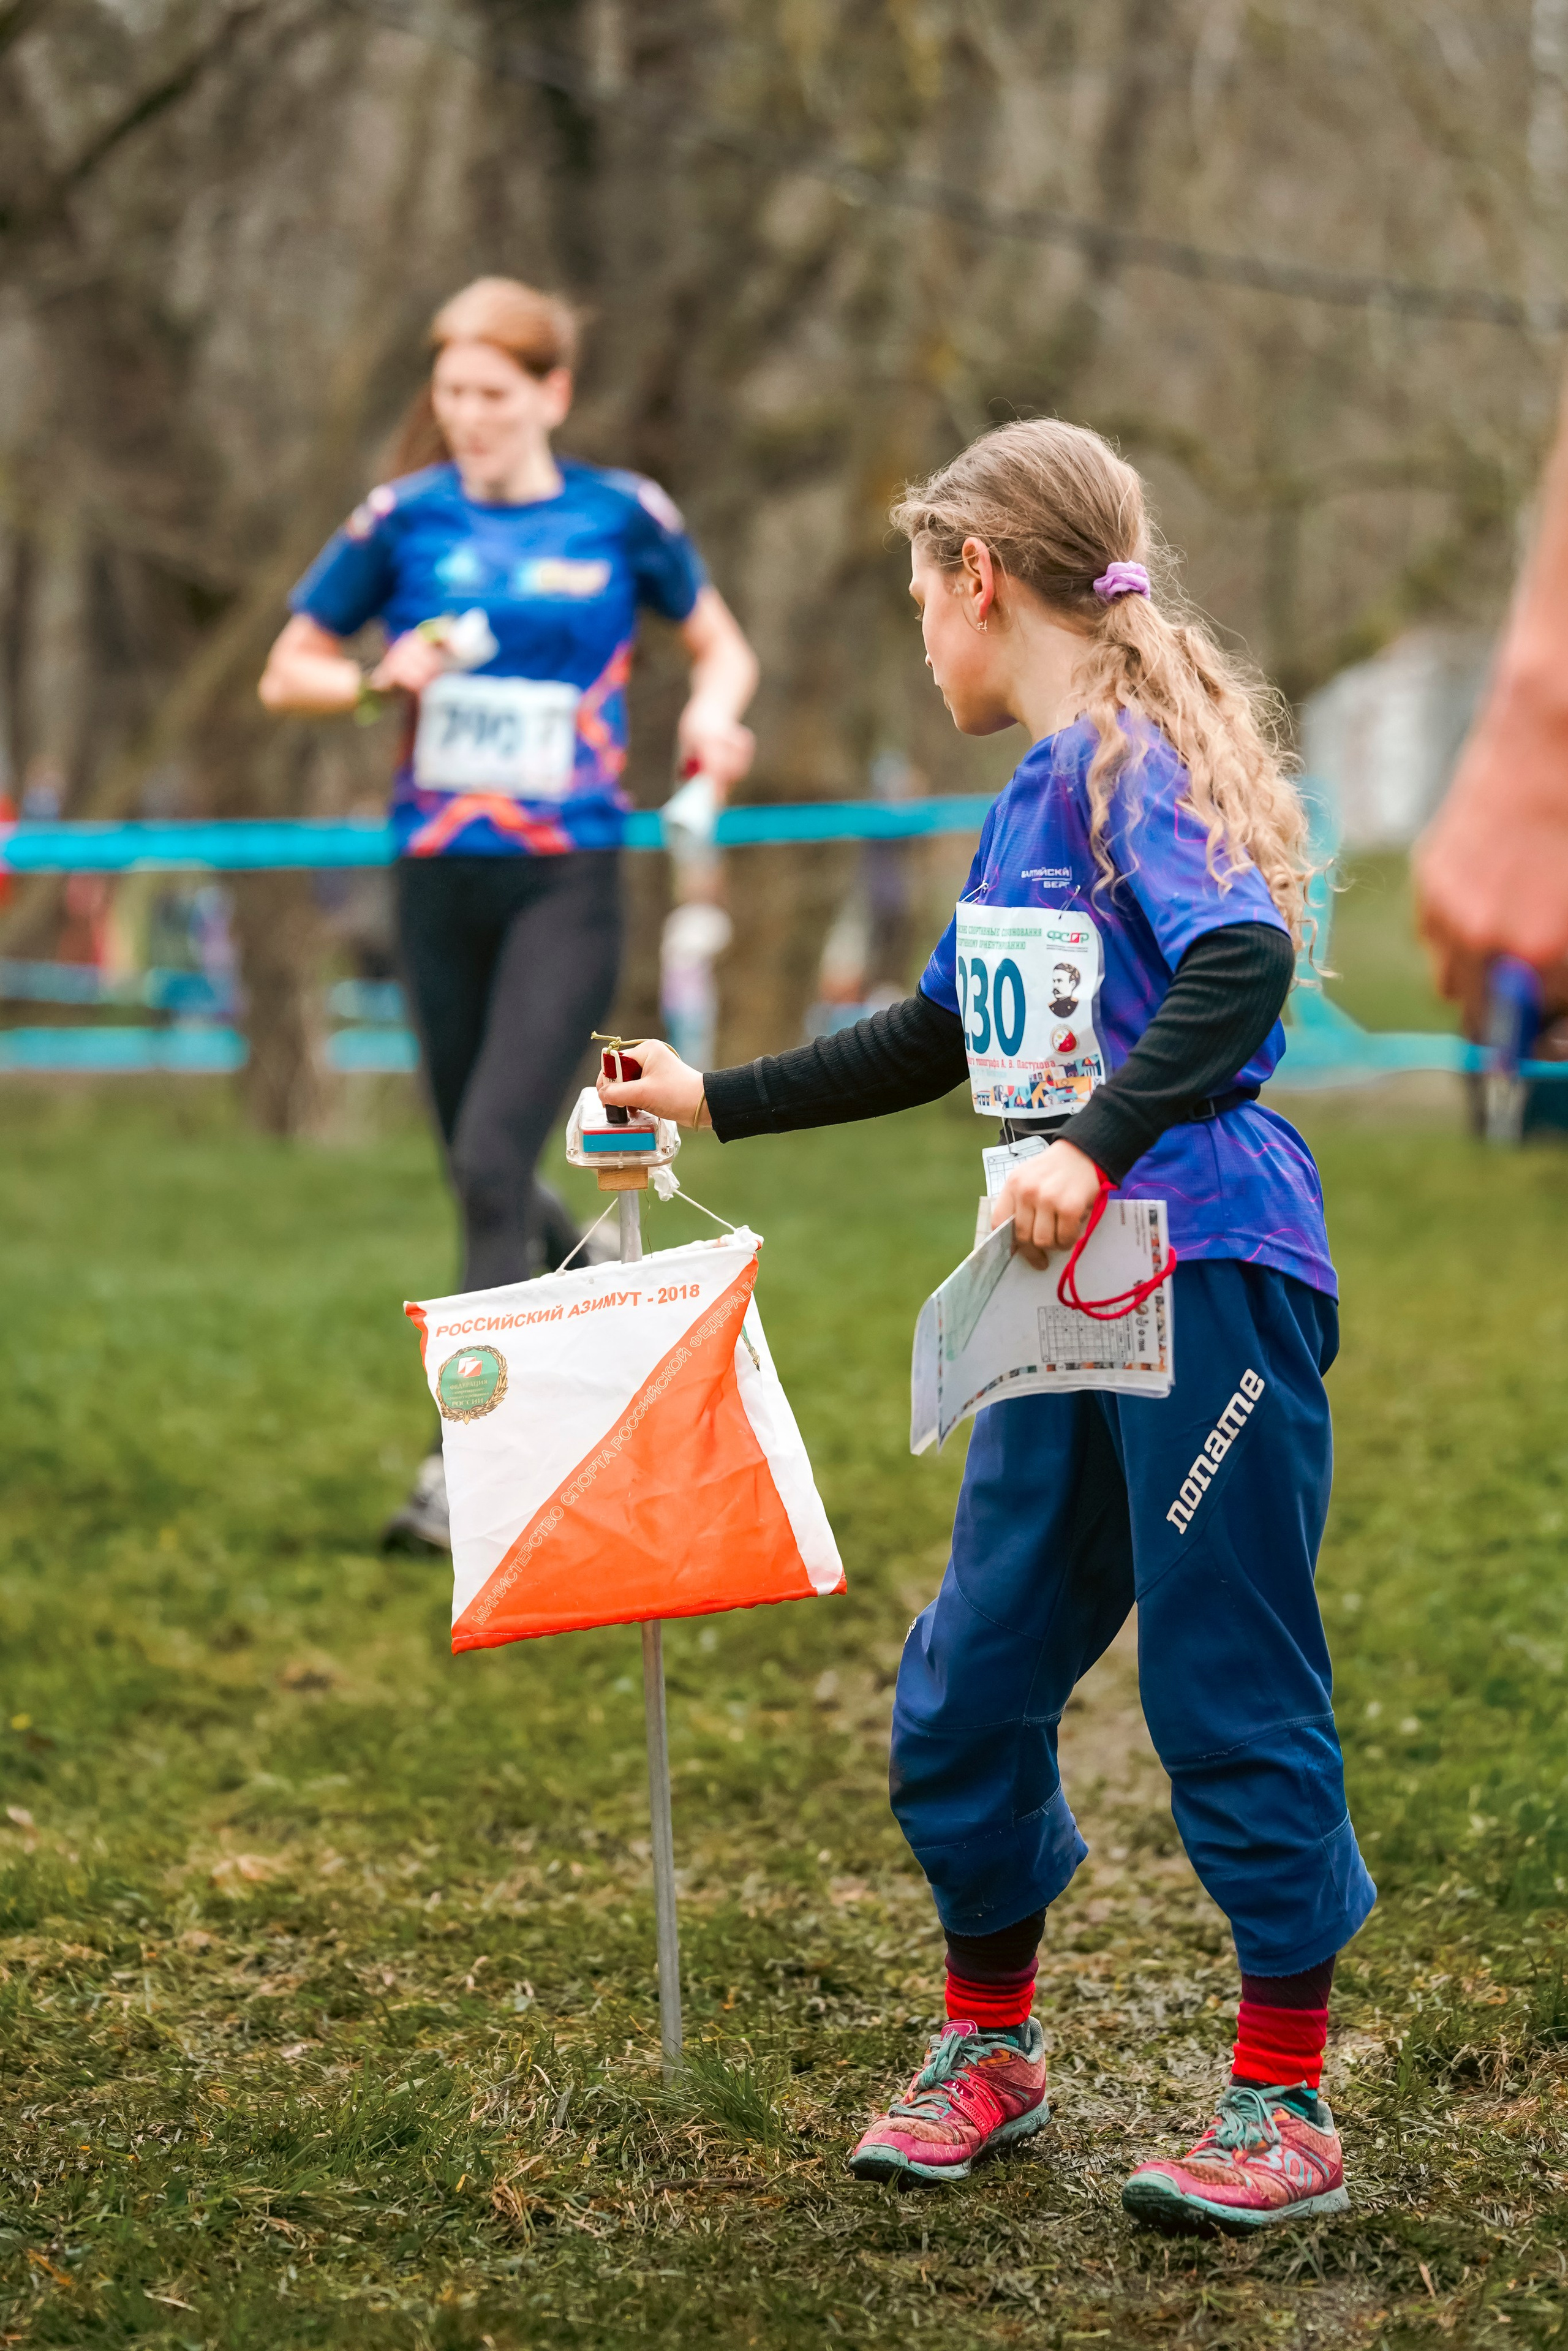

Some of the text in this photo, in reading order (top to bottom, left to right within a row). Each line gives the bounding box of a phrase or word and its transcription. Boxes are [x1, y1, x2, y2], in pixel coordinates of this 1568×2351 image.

[436, 1304, 564, 1337] РОССИЙСКИЙ
[567, 1292, 642, 1318] АЗИМУТ
[658, 1284, 699, 1304] 2018
[450, 1379, 488, 1390] ФЕДЕРАЦИЯ
[452, 1398, 483, 1406] РОССИИ
[1166, 1368, 1265, 1534] noname
[472, 1506, 564, 1625] МИНИСТЕРСТВО
[561, 1450, 617, 1506] СПОРТА
[611, 1347, 692, 1451] РОССИЙСКОЙ
